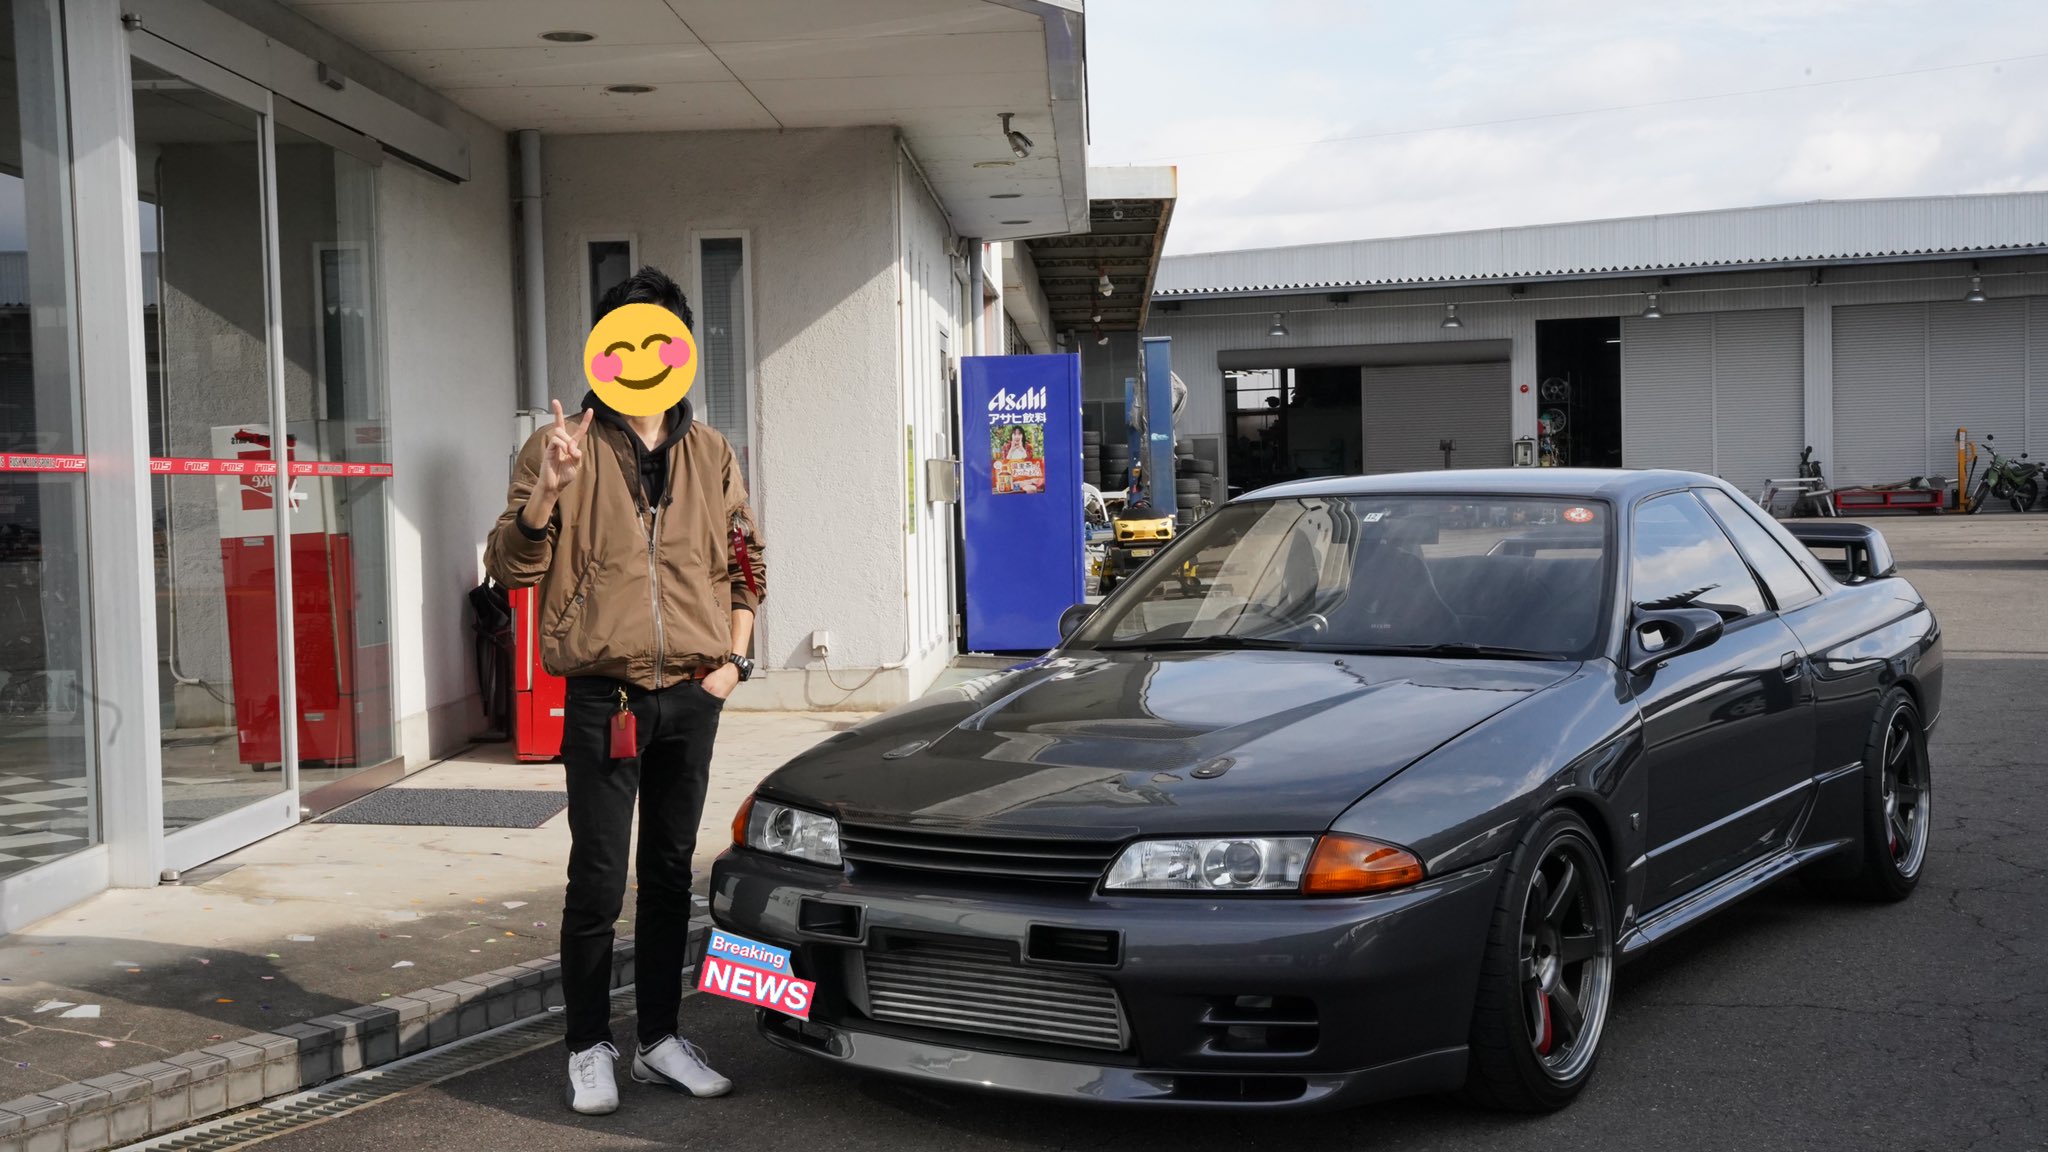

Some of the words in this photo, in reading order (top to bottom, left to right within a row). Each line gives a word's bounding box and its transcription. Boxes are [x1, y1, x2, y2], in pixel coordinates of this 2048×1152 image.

[988, 386, 1047, 411] Asahi
[988, 412, 1047, 424] アサヒ飲料
[55, 458, 86, 469] rms
[184, 461, 209, 471] rms
[221, 462, 244, 472] rms
[255, 463, 276, 472] rms
[292, 464, 313, 473] rms
